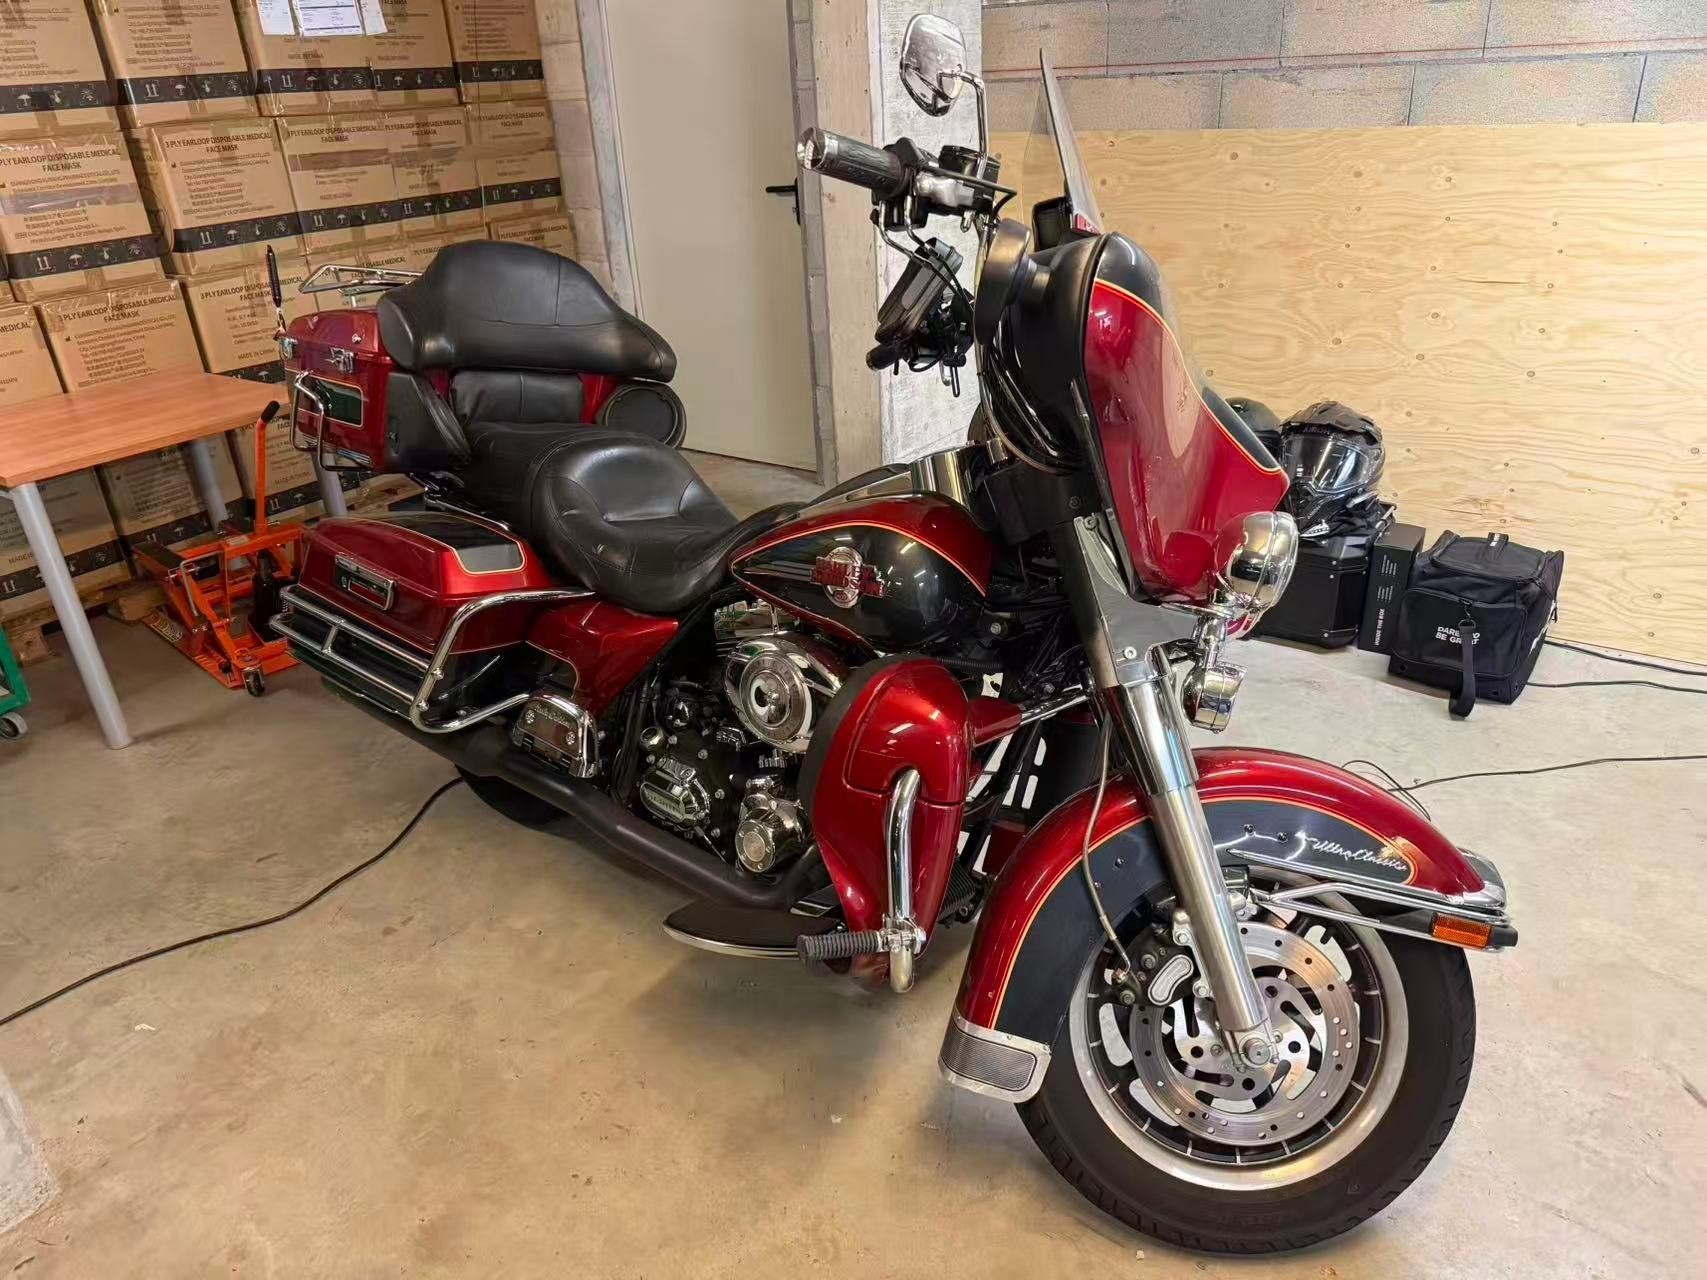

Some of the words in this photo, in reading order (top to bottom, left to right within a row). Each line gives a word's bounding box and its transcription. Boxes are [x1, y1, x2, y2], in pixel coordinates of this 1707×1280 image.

[182, 137, 210, 146] EARLOOP
[211, 134, 246, 144] DISPOSABLE
[246, 132, 273, 141] MEDICAL
[223, 144, 239, 152] MASK
[13, 154, 47, 165] EARLOOP
[48, 150, 91, 161] DISPOSABLE
[91, 147, 121, 157] MEDICAL
[42, 163, 60, 172] FACE
[61, 161, 81, 171] MASK
[217, 285, 244, 297] EARLOOP
[240, 292, 254, 301] FACE
[64, 312, 76, 321] PLY
[77, 306, 108, 318] EARLOOP
[149, 295, 177, 305] MEDICAL
[103, 313, 121, 324] FACE
[121, 310, 140, 320] MASK
[1376, 619, 1384, 629] THE
[1435, 631, 1448, 641] BE
[1437, 626, 1460, 637] DARE
